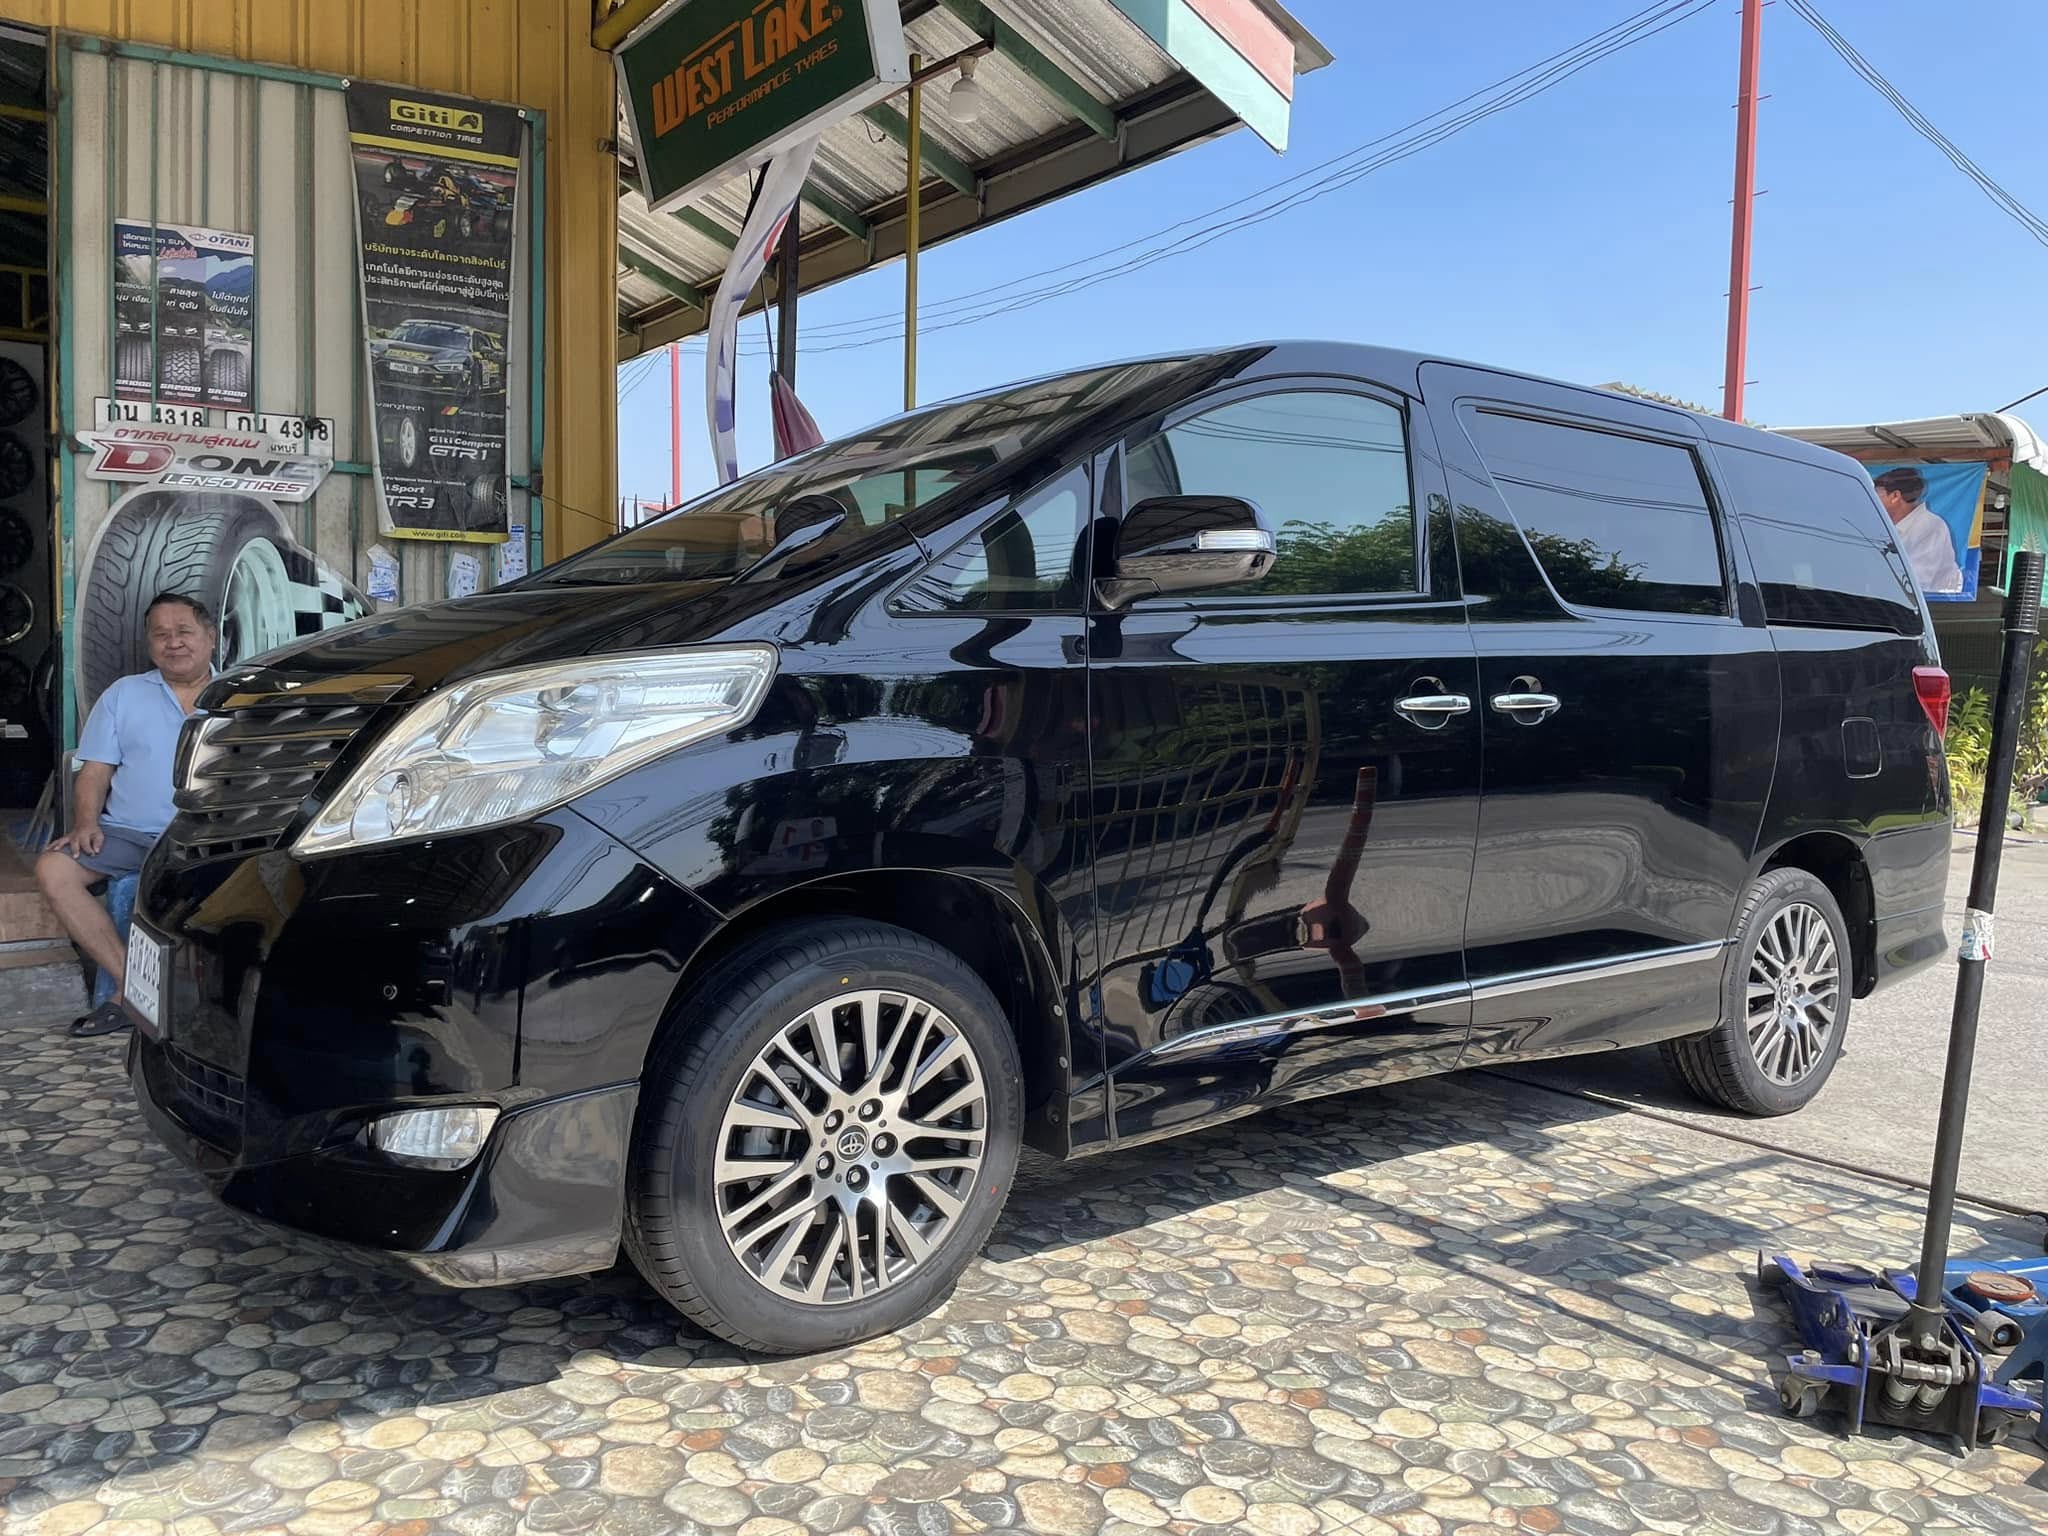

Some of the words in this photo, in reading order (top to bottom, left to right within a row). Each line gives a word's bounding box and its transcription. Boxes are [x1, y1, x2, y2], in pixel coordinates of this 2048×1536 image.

[652, 41, 735, 138] WEST
[742, 0, 833, 80] LAKE
[706, 65, 792, 130] PERFORMANCE
[794, 38, 839, 76] TYRES
[396, 105, 449, 125] Giti
[390, 124, 452, 140] COMPETITION
[456, 134, 483, 145] TIRES
[208, 235, 250, 248] OTANI
[95, 440, 315, 479] D-ONE
[162, 472, 235, 489] LENSO
[240, 477, 303, 493] TIRES
[385, 494, 435, 509] TR3
